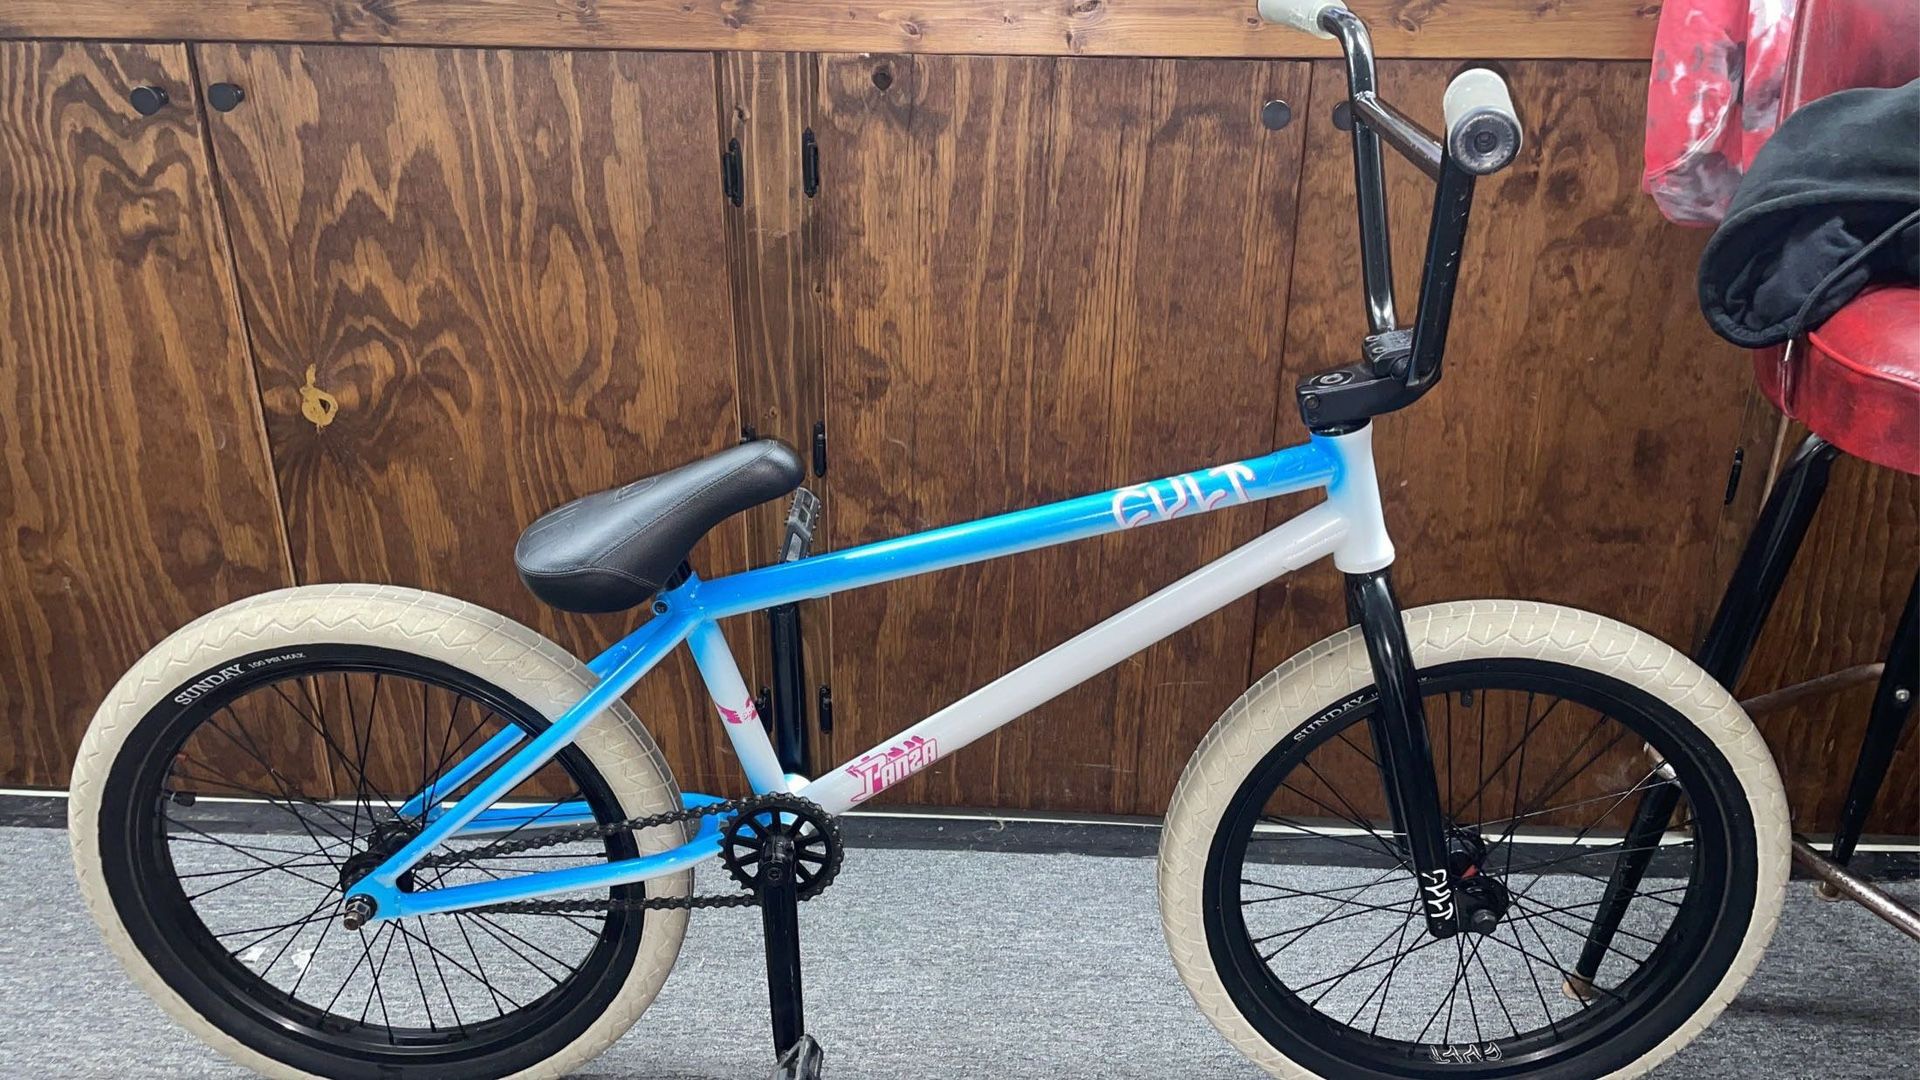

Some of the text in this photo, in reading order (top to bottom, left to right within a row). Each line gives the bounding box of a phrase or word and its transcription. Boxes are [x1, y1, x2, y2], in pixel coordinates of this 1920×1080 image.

[1112, 462, 1255, 529] CULT
[174, 663, 245, 705] SUNDAY
[1293, 695, 1364, 742] SUNDAY
[1421, 868, 1454, 920] CULT
[1429, 1042, 1502, 1064] CULT
